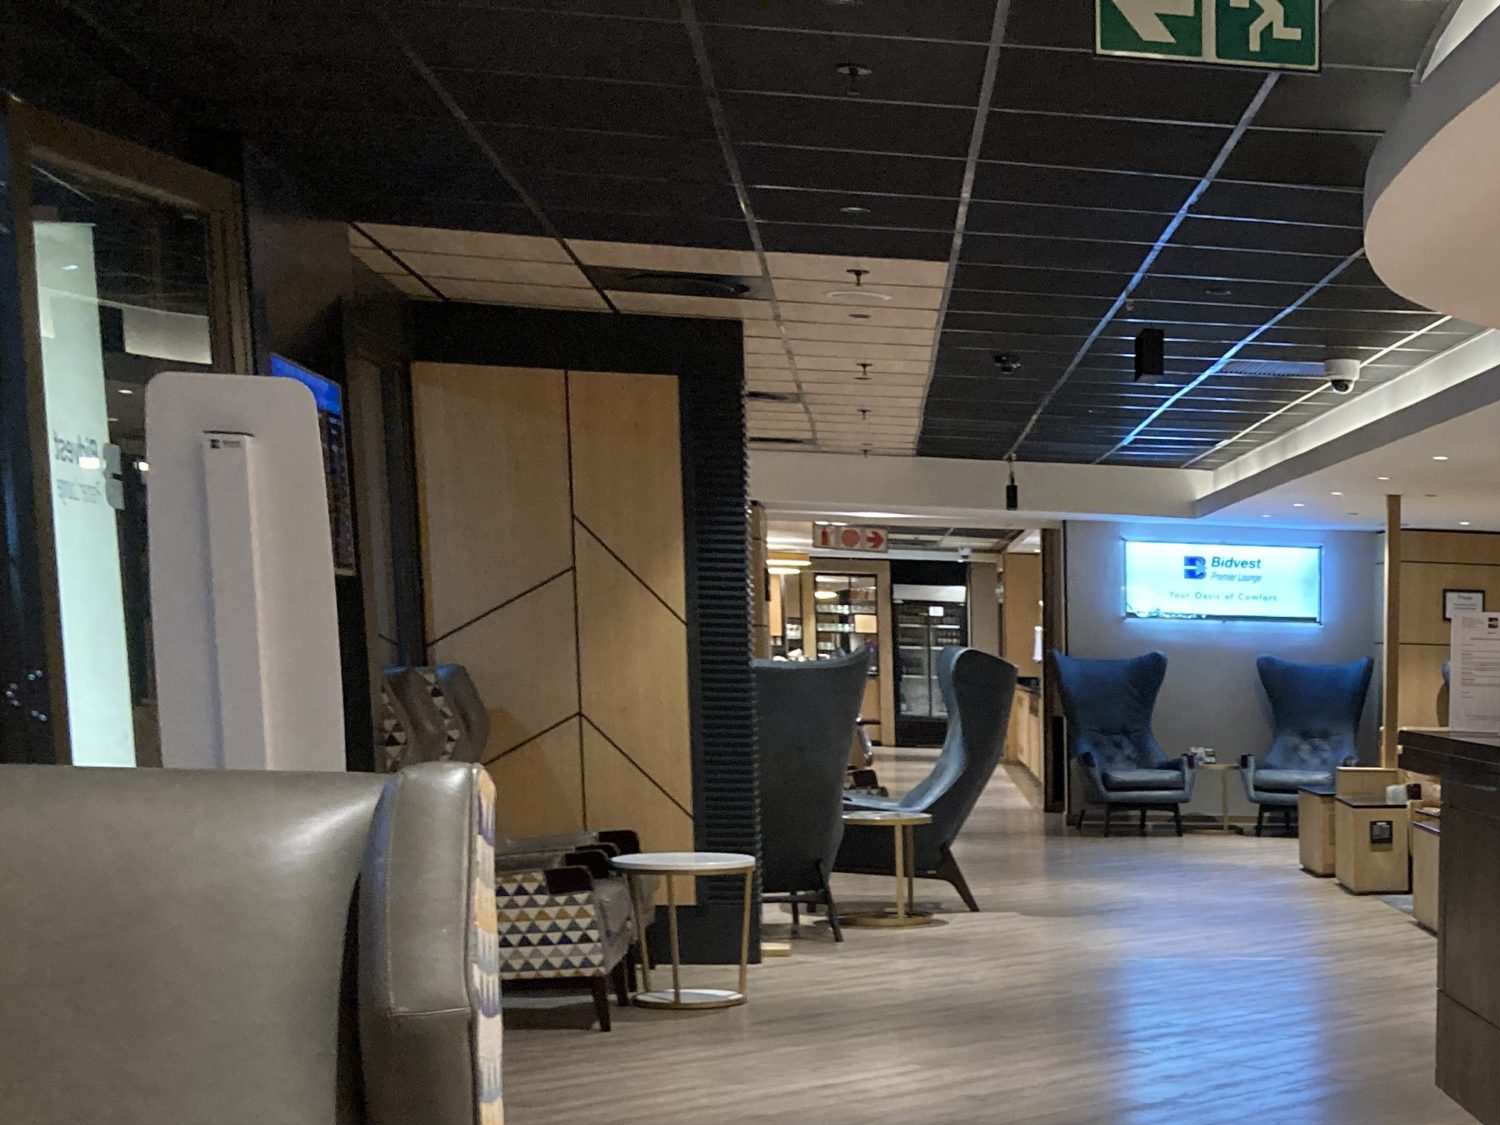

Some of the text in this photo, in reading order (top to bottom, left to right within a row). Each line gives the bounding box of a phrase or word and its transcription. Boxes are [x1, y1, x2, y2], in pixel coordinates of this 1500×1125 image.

[1211, 556, 1262, 569] Bidvest
[1194, 592, 1220, 600] Oasis
[1238, 593, 1278, 602] Comfort
